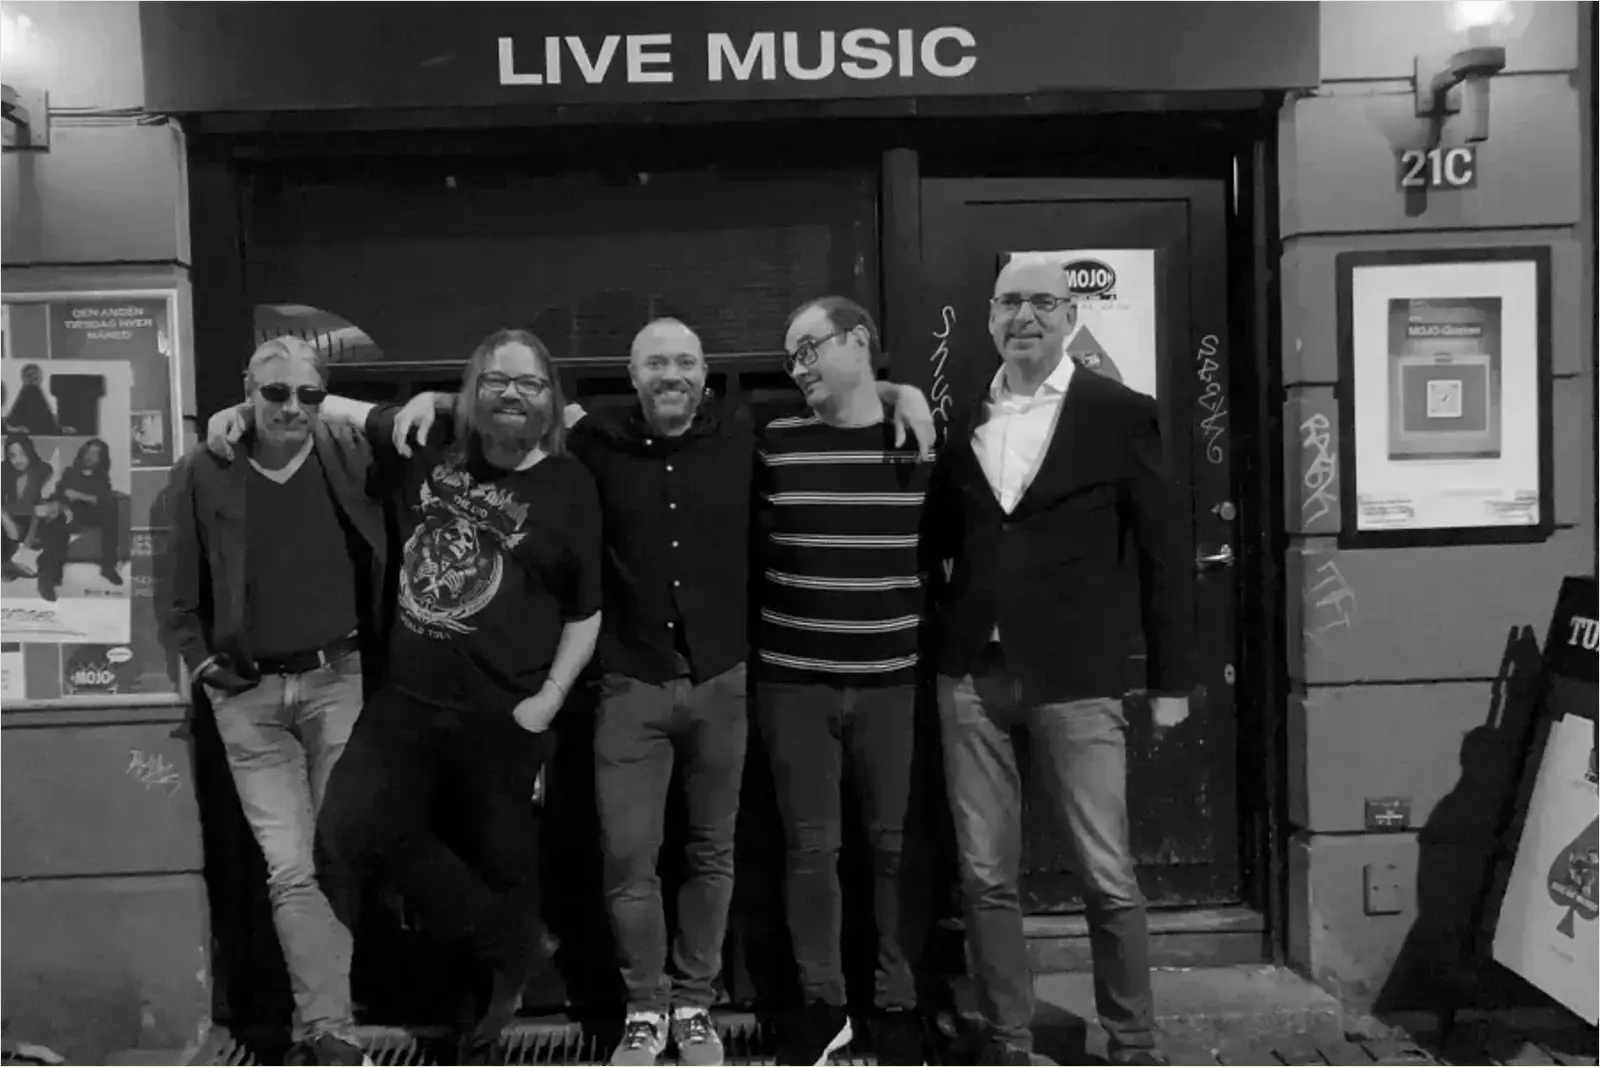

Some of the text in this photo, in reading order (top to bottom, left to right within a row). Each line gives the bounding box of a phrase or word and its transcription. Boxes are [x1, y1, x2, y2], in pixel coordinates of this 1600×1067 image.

[498, 26, 977, 85] LIVE MUSIC
[1402, 148, 1473, 187] 21C
[1066, 268, 1107, 288] MOJO
[1567, 615, 1599, 652] TU
[74, 670, 110, 685] MOJO
